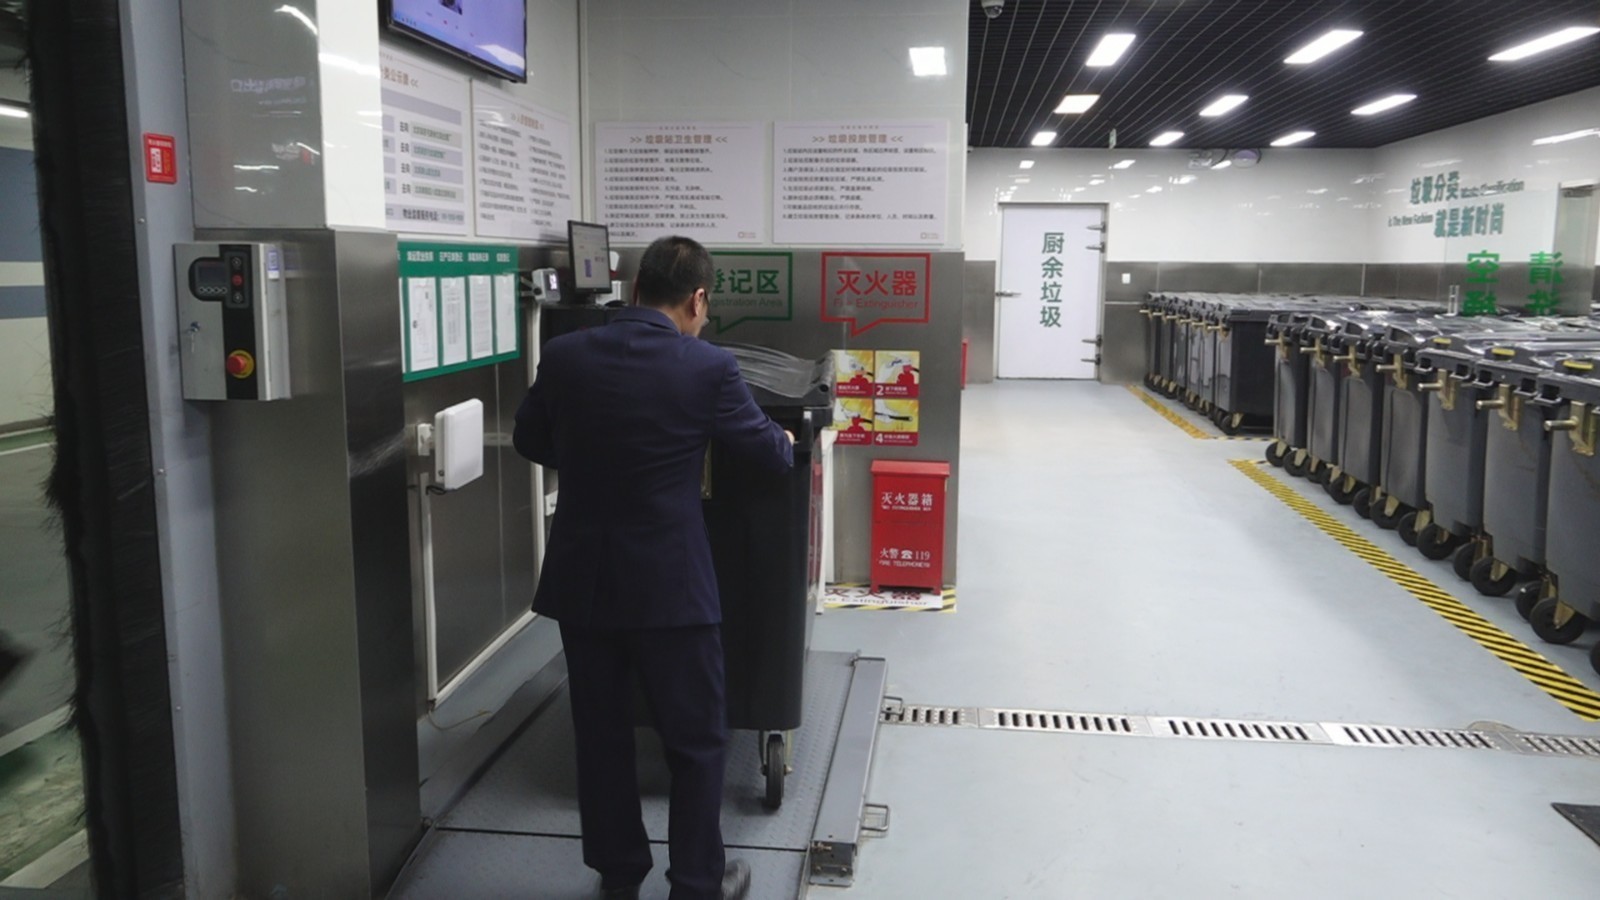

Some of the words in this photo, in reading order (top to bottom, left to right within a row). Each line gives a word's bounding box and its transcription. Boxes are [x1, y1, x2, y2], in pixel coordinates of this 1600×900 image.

[646, 134, 712, 145] 垃圾站卫生管理
[828, 133, 888, 144] 垃圾投放管理
[1410, 171, 1460, 205] 垃圾分类
[1434, 203, 1504, 237] 就是新时尚
[836, 270, 917, 296] 灭火器
[1040, 232, 1064, 328] 厨余垃圾
[712, 297, 756, 308] gistration
[759, 298, 783, 307] Area
[856, 298, 918, 310] Extinguisher
[876, 385, 885, 396] 2
[875, 433, 884, 443] 4
[882, 492, 933, 506] 灭火器箱
[880, 548, 899, 559] 火警
[915, 550, 931, 560] 119
